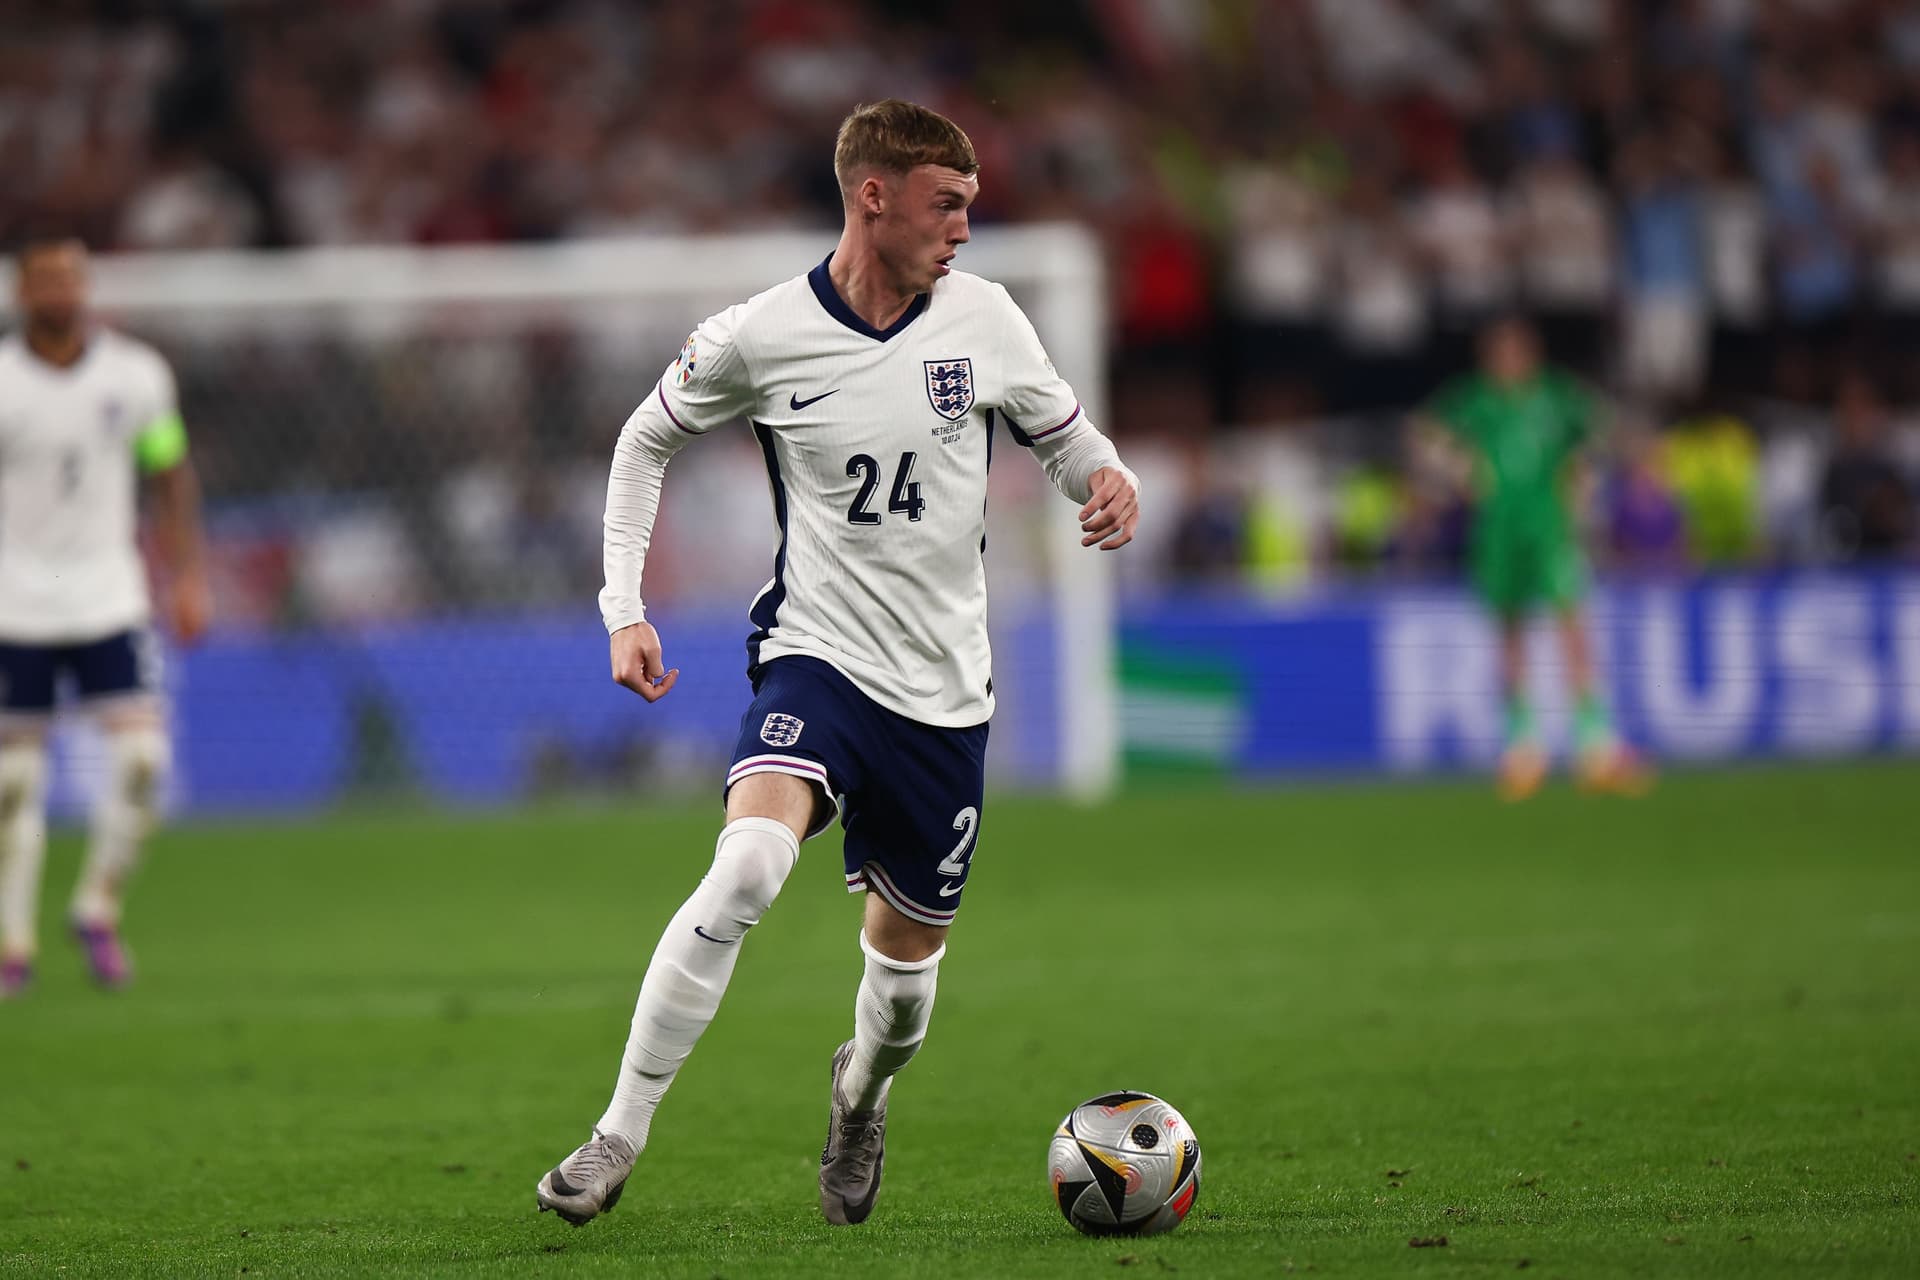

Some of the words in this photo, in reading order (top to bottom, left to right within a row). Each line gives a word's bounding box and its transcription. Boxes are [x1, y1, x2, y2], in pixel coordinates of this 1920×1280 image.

[846, 451, 925, 526] 24
[1380, 582, 1920, 765] RUS
[937, 806, 979, 877] 2
